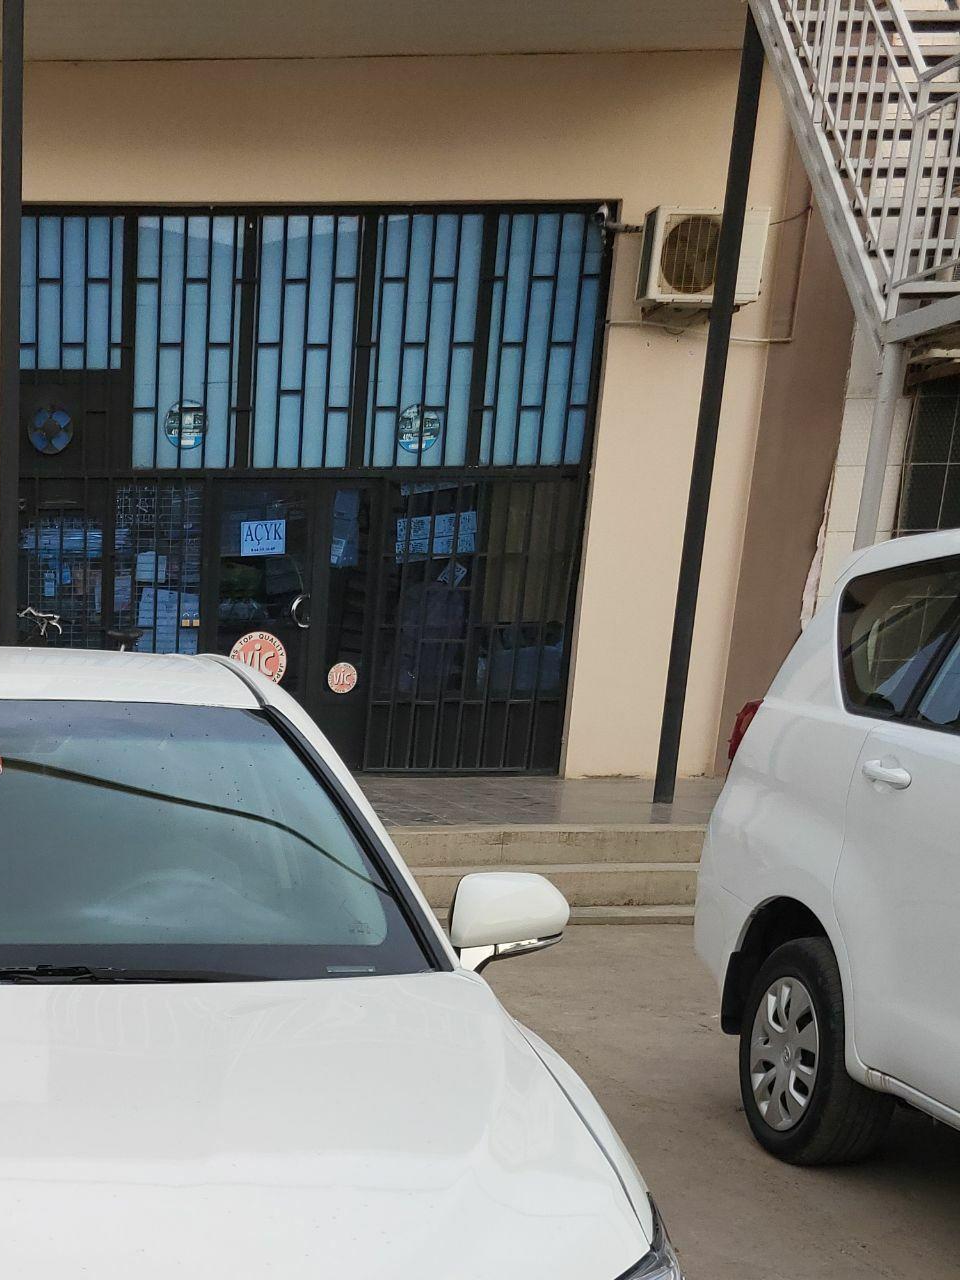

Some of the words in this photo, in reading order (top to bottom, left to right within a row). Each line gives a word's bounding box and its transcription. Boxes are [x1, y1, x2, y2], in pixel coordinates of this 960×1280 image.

[244, 523, 282, 545] AÇYK
[239, 634, 254, 646] TOP
[258, 633, 285, 657] QUALITY
[272, 663, 284, 683] JAPA
